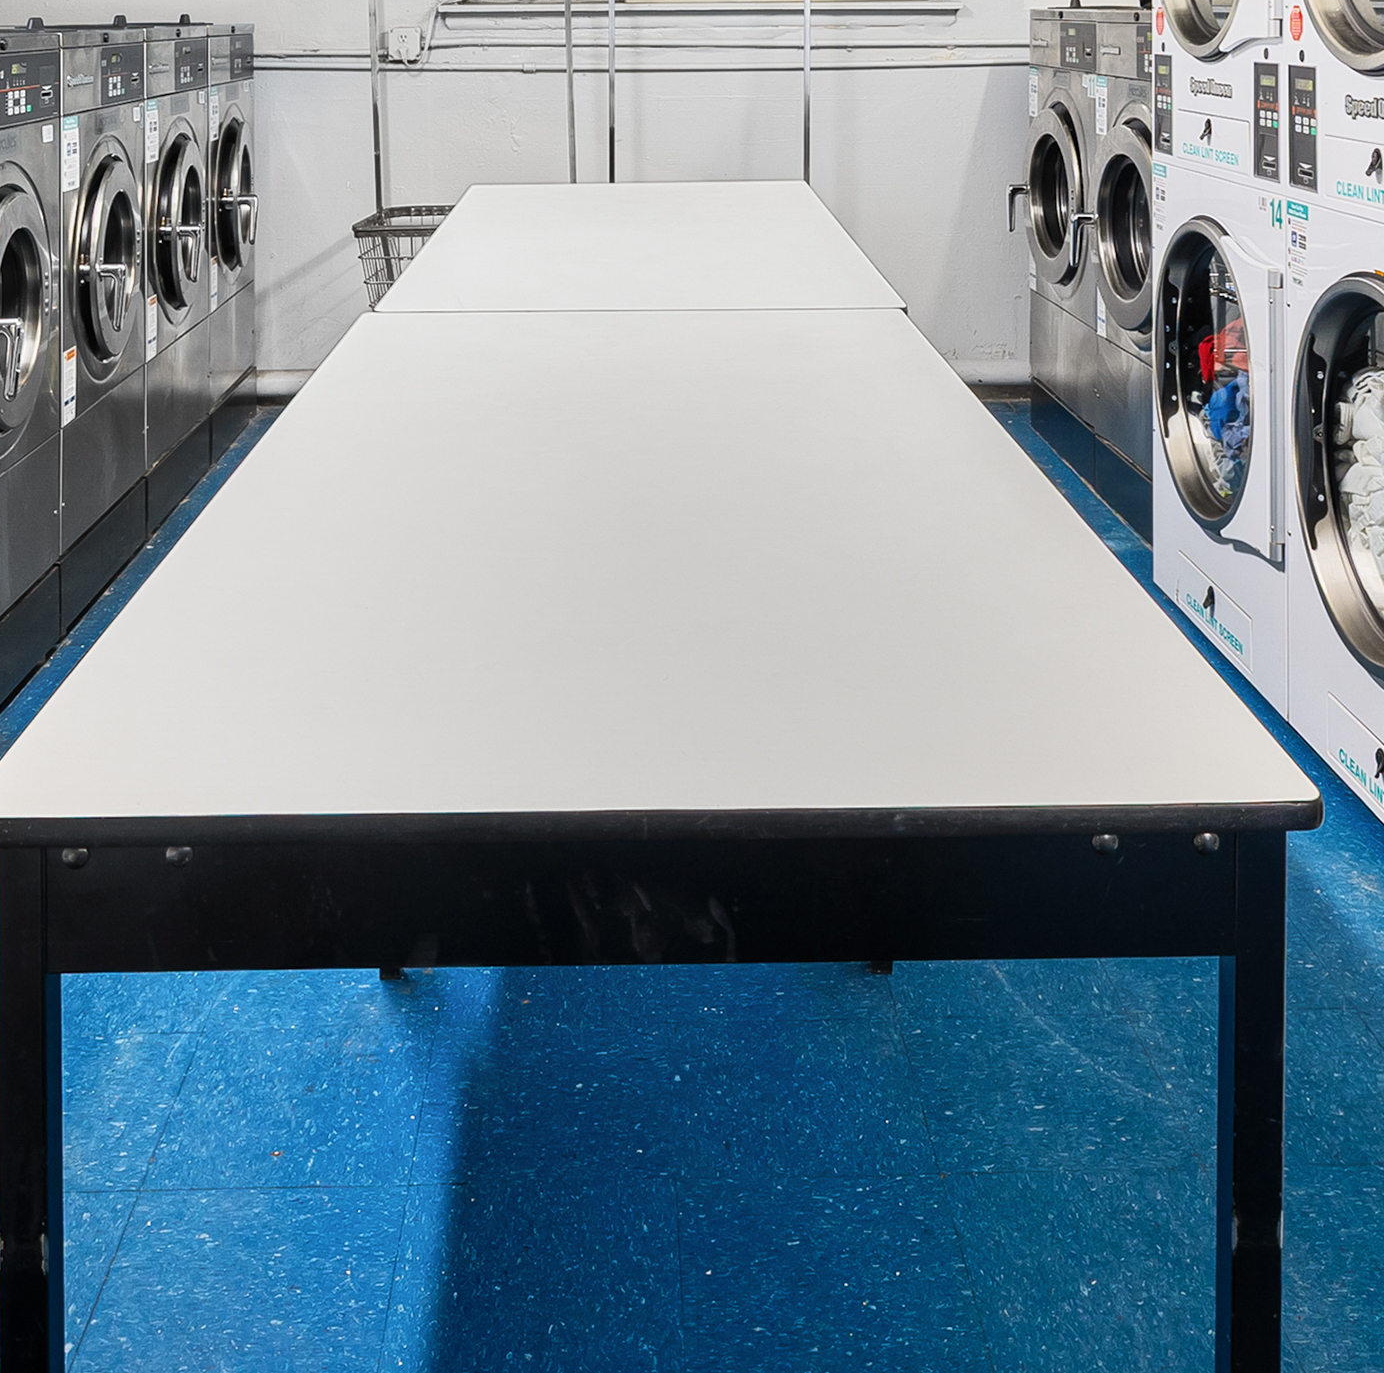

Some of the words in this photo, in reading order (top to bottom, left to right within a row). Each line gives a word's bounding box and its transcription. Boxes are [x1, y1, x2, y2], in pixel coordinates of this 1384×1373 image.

[1183, 142, 1200, 157] CLEAN
[1201, 146, 1214, 160] LINT
[1215, 149, 1239, 166] SCREEN
[1336, 181, 1364, 200] CLEAN
[1270, 198, 1283, 229] 14
[1339, 748, 1367, 786] CLEAN
